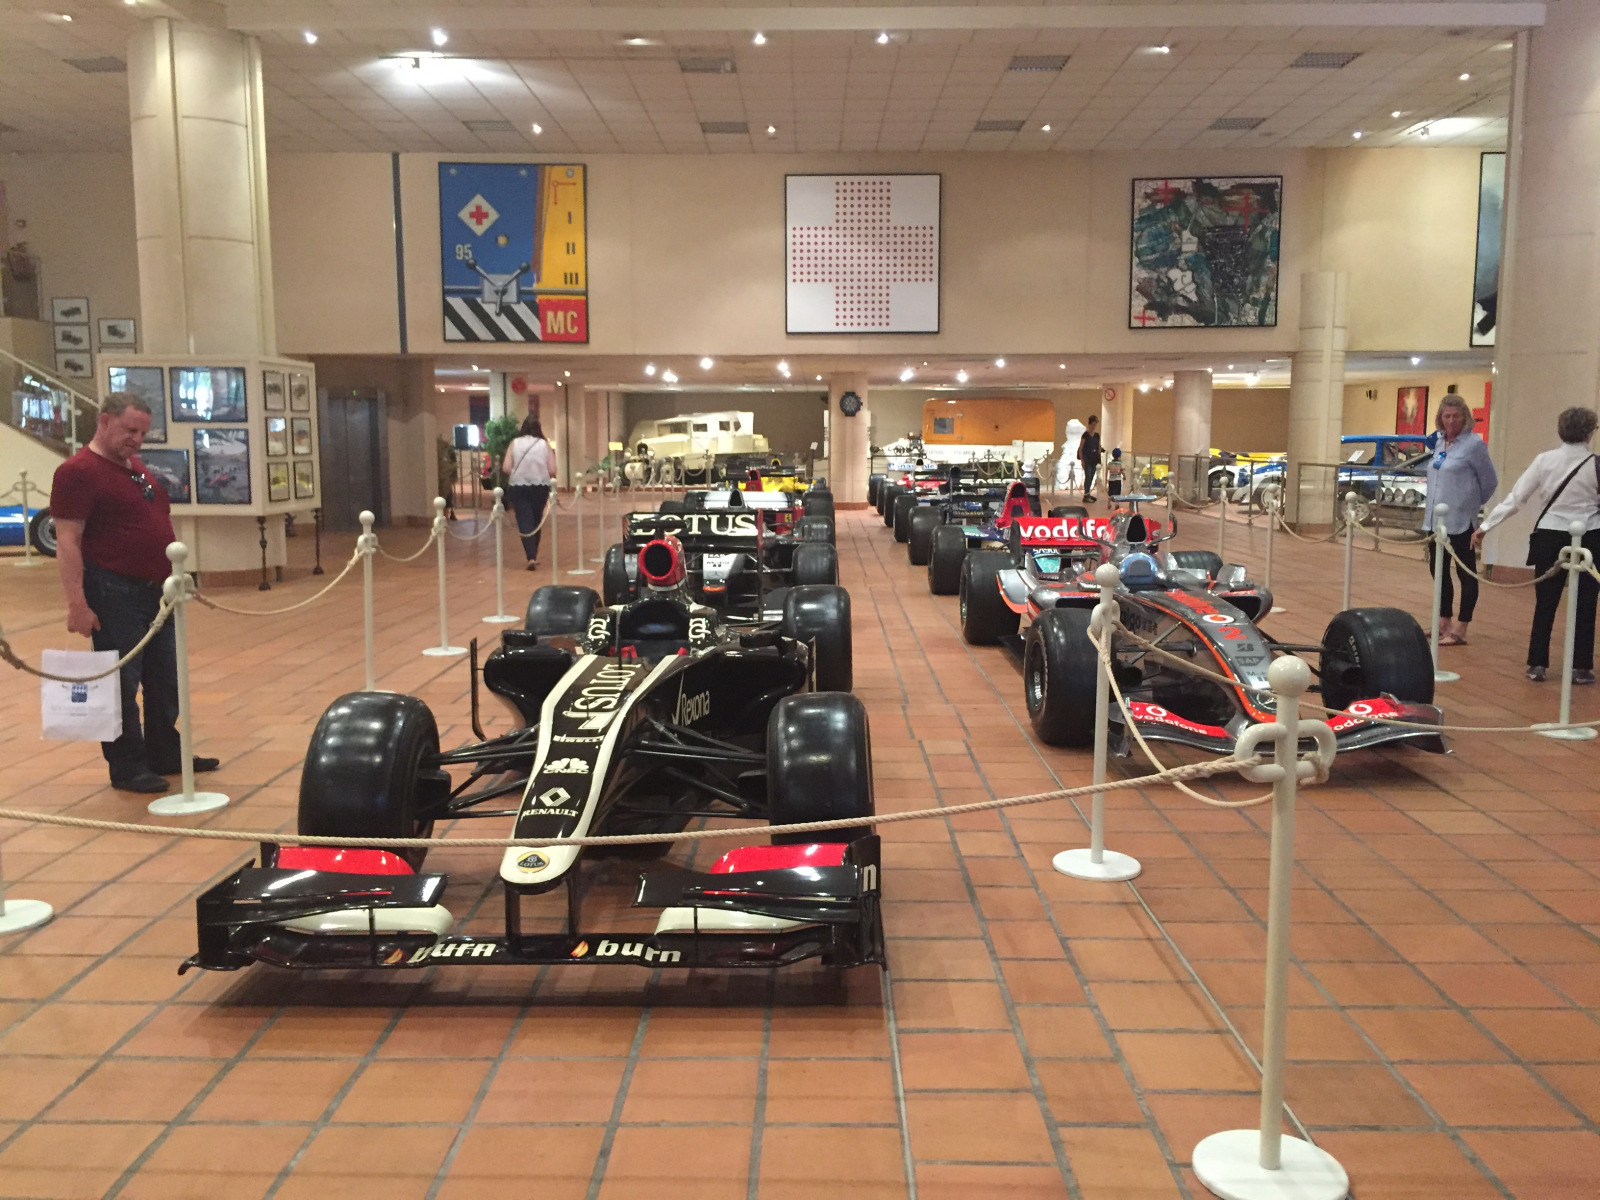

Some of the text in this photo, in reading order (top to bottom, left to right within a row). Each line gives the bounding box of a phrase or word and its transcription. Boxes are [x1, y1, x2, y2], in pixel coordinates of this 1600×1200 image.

[455, 244, 472, 260] 95
[546, 311, 578, 334] MC
[1218, 627, 1247, 639] 2
[574, 664, 642, 710] LOTUS
[681, 690, 711, 726] Rexona
[1133, 714, 1208, 735] vodafone
[521, 808, 579, 817] RENAULT
[596, 940, 682, 962] burn
